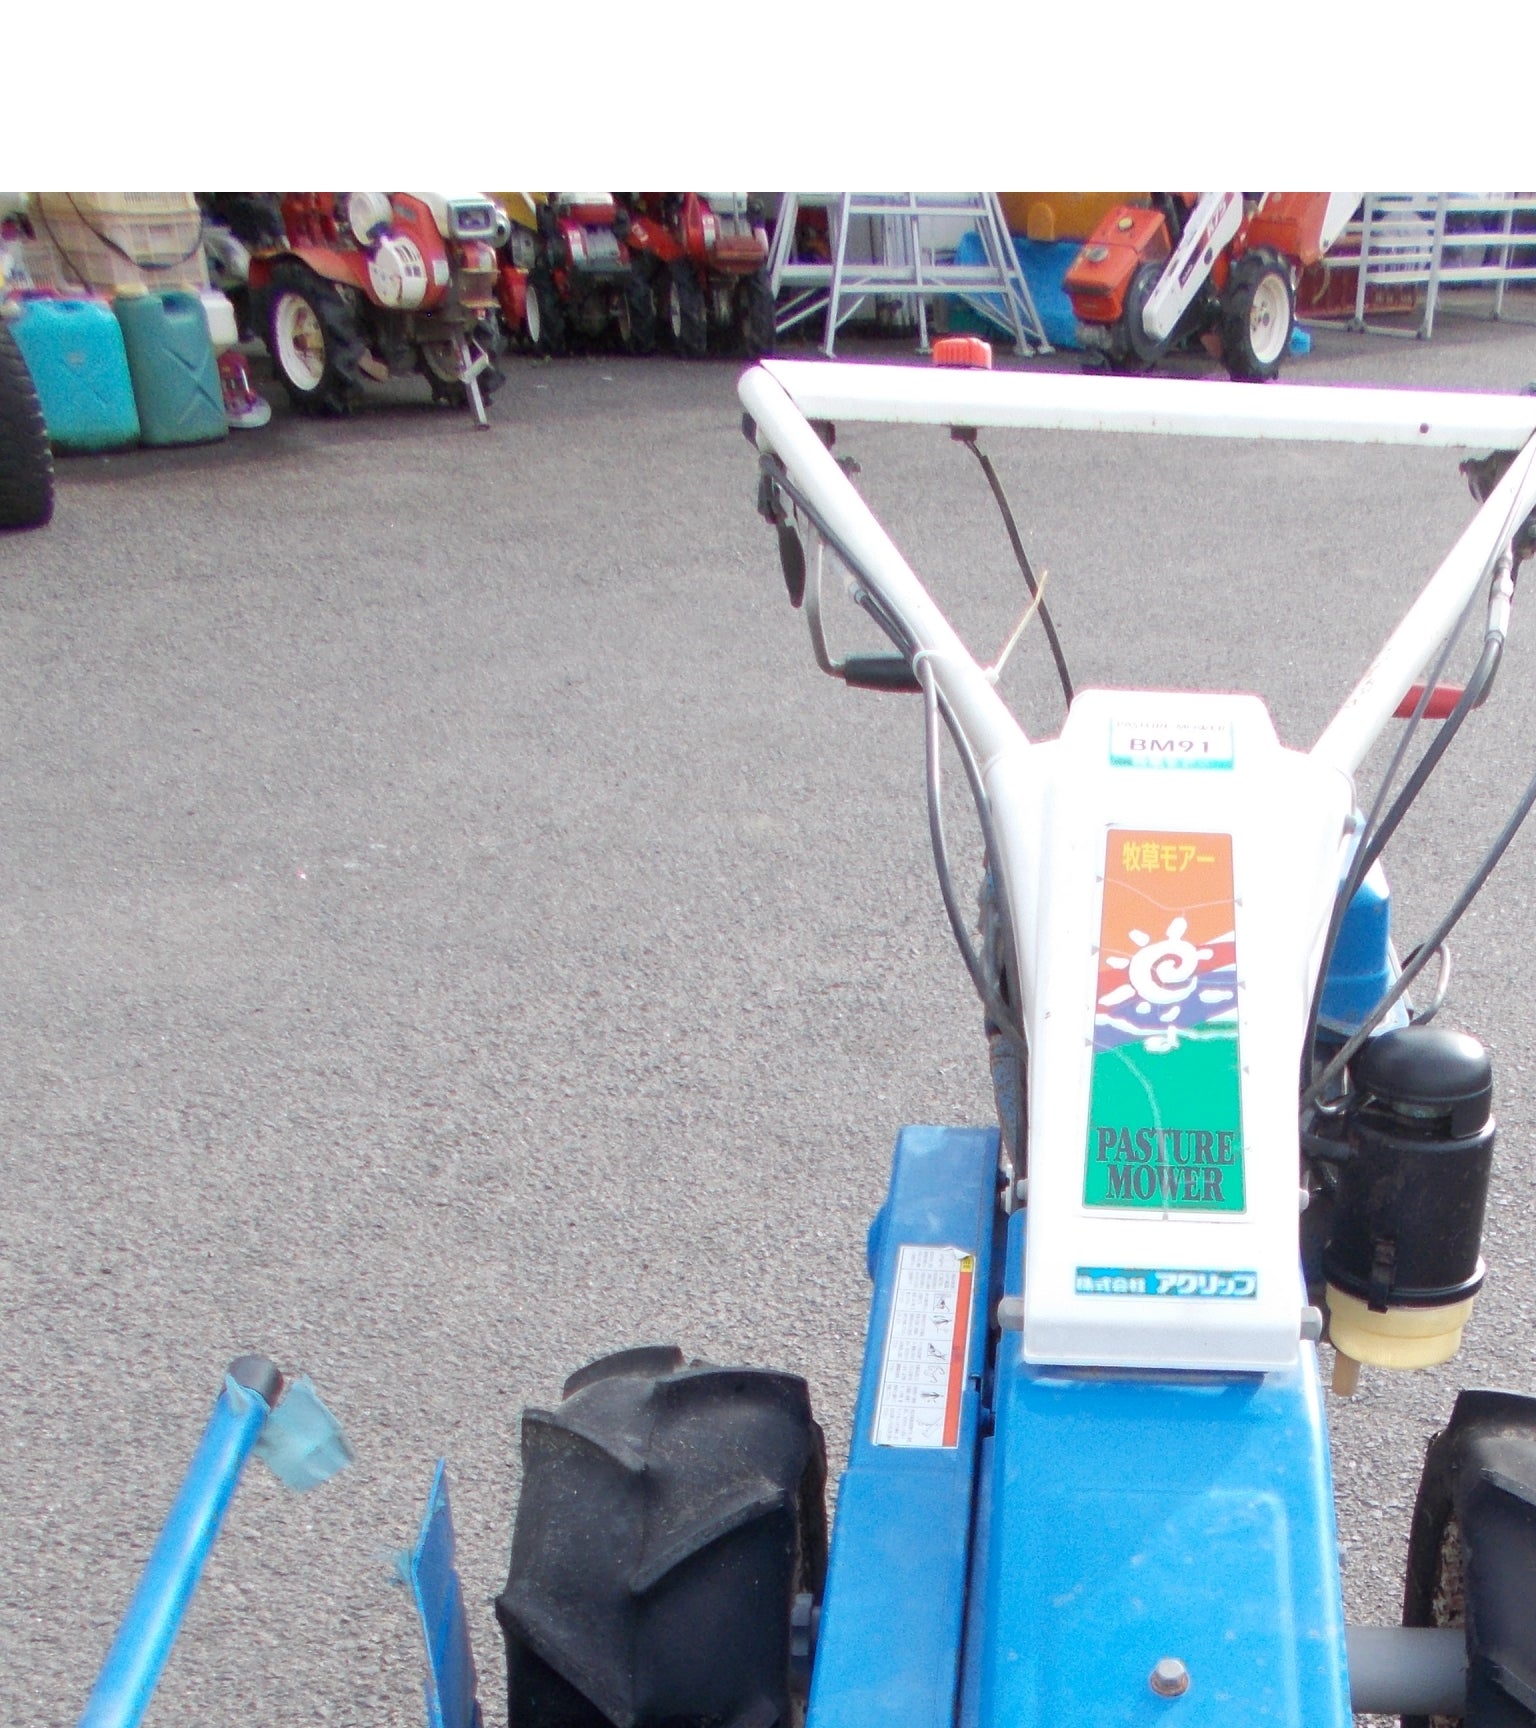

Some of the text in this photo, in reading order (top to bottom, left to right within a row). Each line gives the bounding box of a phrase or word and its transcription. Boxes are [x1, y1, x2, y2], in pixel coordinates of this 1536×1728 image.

[1129, 738, 1210, 754] BM91
[1122, 841, 1216, 873] 牧草モアー
[1096, 1126, 1236, 1166] PASTURE
[1105, 1164, 1225, 1202] MOWER
